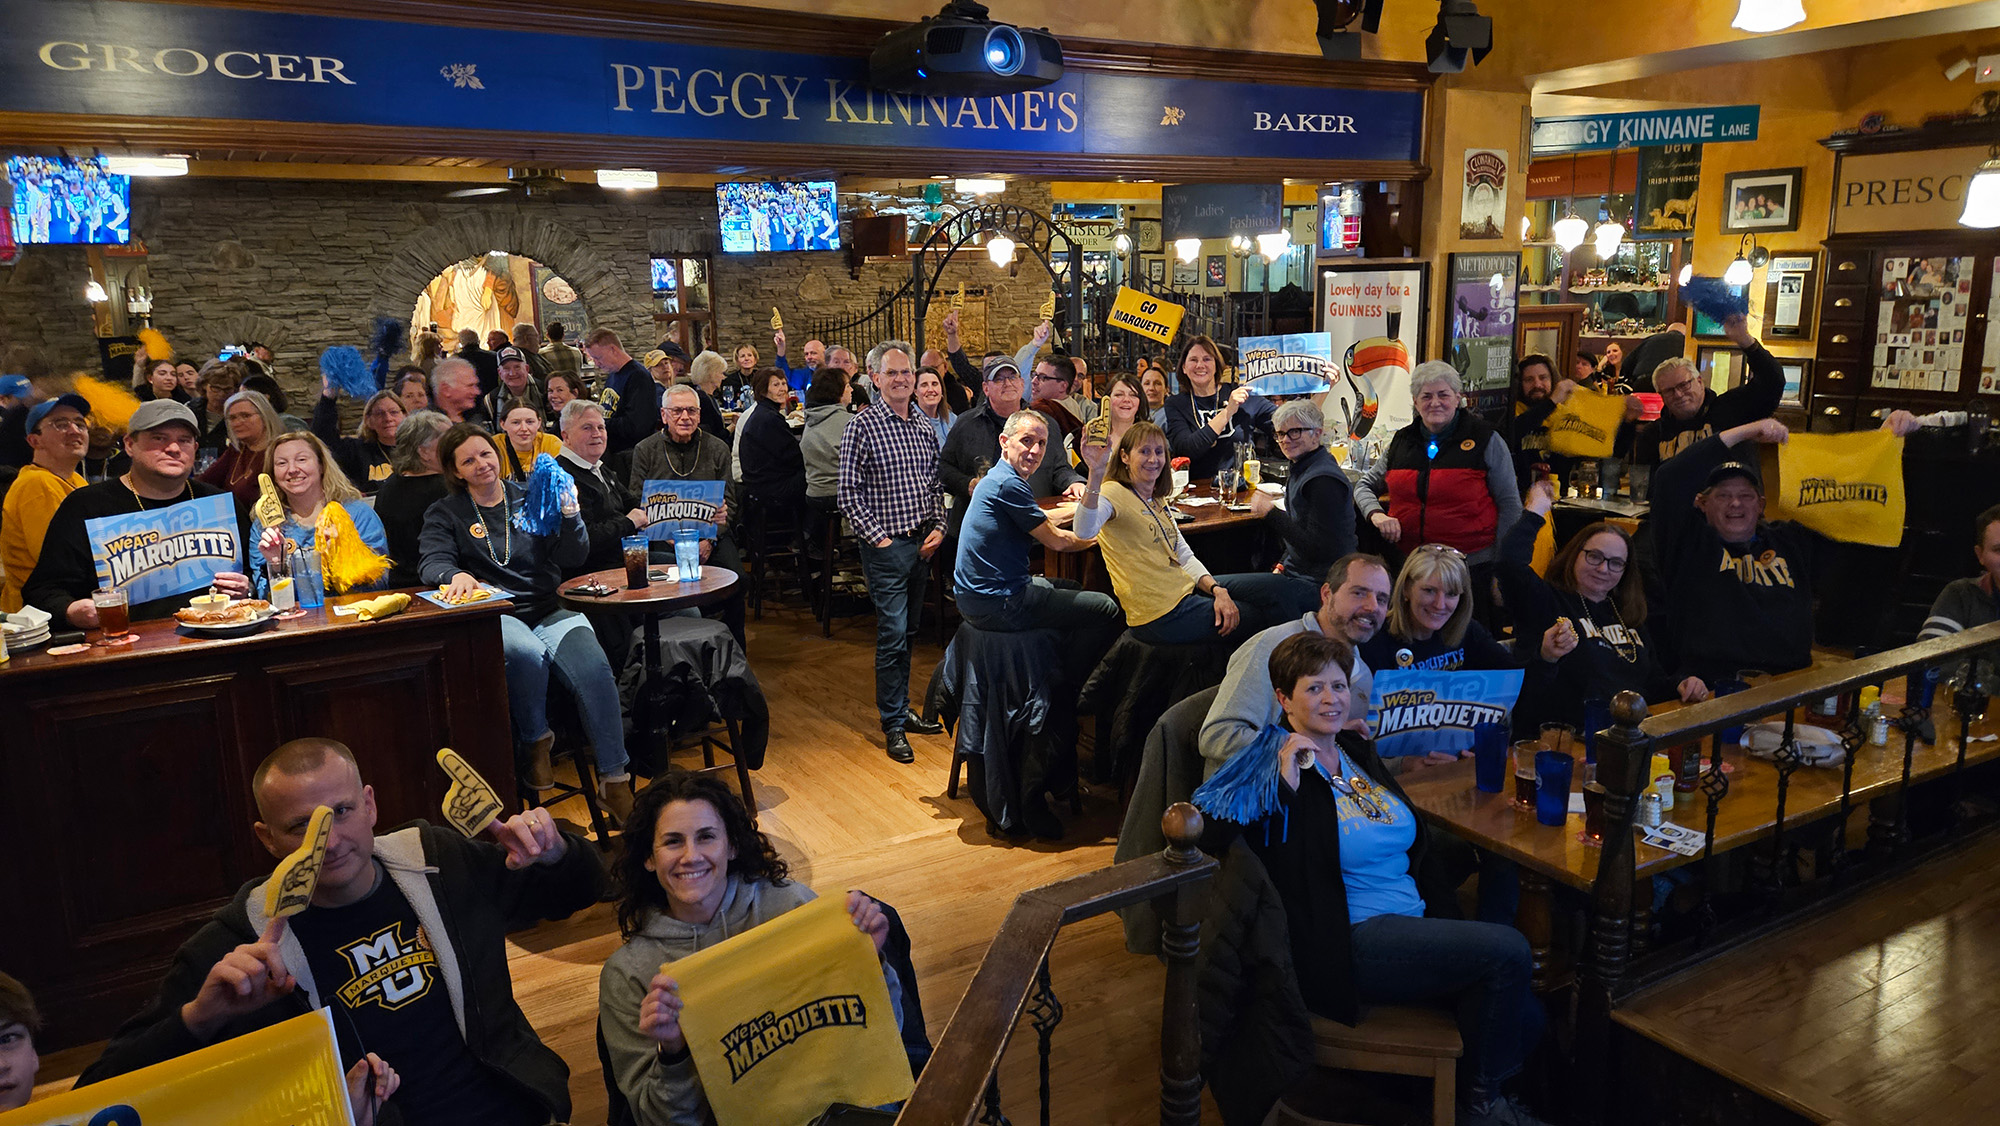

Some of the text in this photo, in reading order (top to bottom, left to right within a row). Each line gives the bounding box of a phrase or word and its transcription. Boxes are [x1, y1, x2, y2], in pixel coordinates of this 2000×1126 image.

[38, 41, 357, 85] GROCER
[610, 63, 1079, 134] PEGGY KINNANE'S
[1253, 111, 1358, 134] BAKER
[1619, 114, 1715, 142] KINNANE
[1721, 123, 1750, 137] LANE
[1647, 174, 1701, 185] IRISH WHISKE
[1167, 193, 1188, 205] New
[1843, 174, 1962, 207] PRESC
[1194, 203, 1224, 217] Ladies
[1051, 224, 1114, 237] HISKEY
[1229, 214, 1275, 230] Fashions
[1070, 237, 1099, 246] ONDER
[1458, 256, 1516, 272] METROPOLIS
[1790, 260, 1810, 269] Herald
[1330, 282, 1410, 299] Lovely day for a
[1140, 300, 1158, 315] GO
[1329, 301, 1382, 318] GUINNESS
[1113, 309, 1170, 337] MARQUETTE
[1247, 355, 1326, 380] MARQUETTE
[1801, 484, 1887, 506] MARQUETTE
[647, 502, 716, 523] MARQUETTE
[110, 533, 233, 585] MARQUETTE
[1378, 703, 1504, 737] MARQUETTE
[349, 952, 431, 995] MARQUETTE
[728, 996, 865, 1078] MARQUETTE
